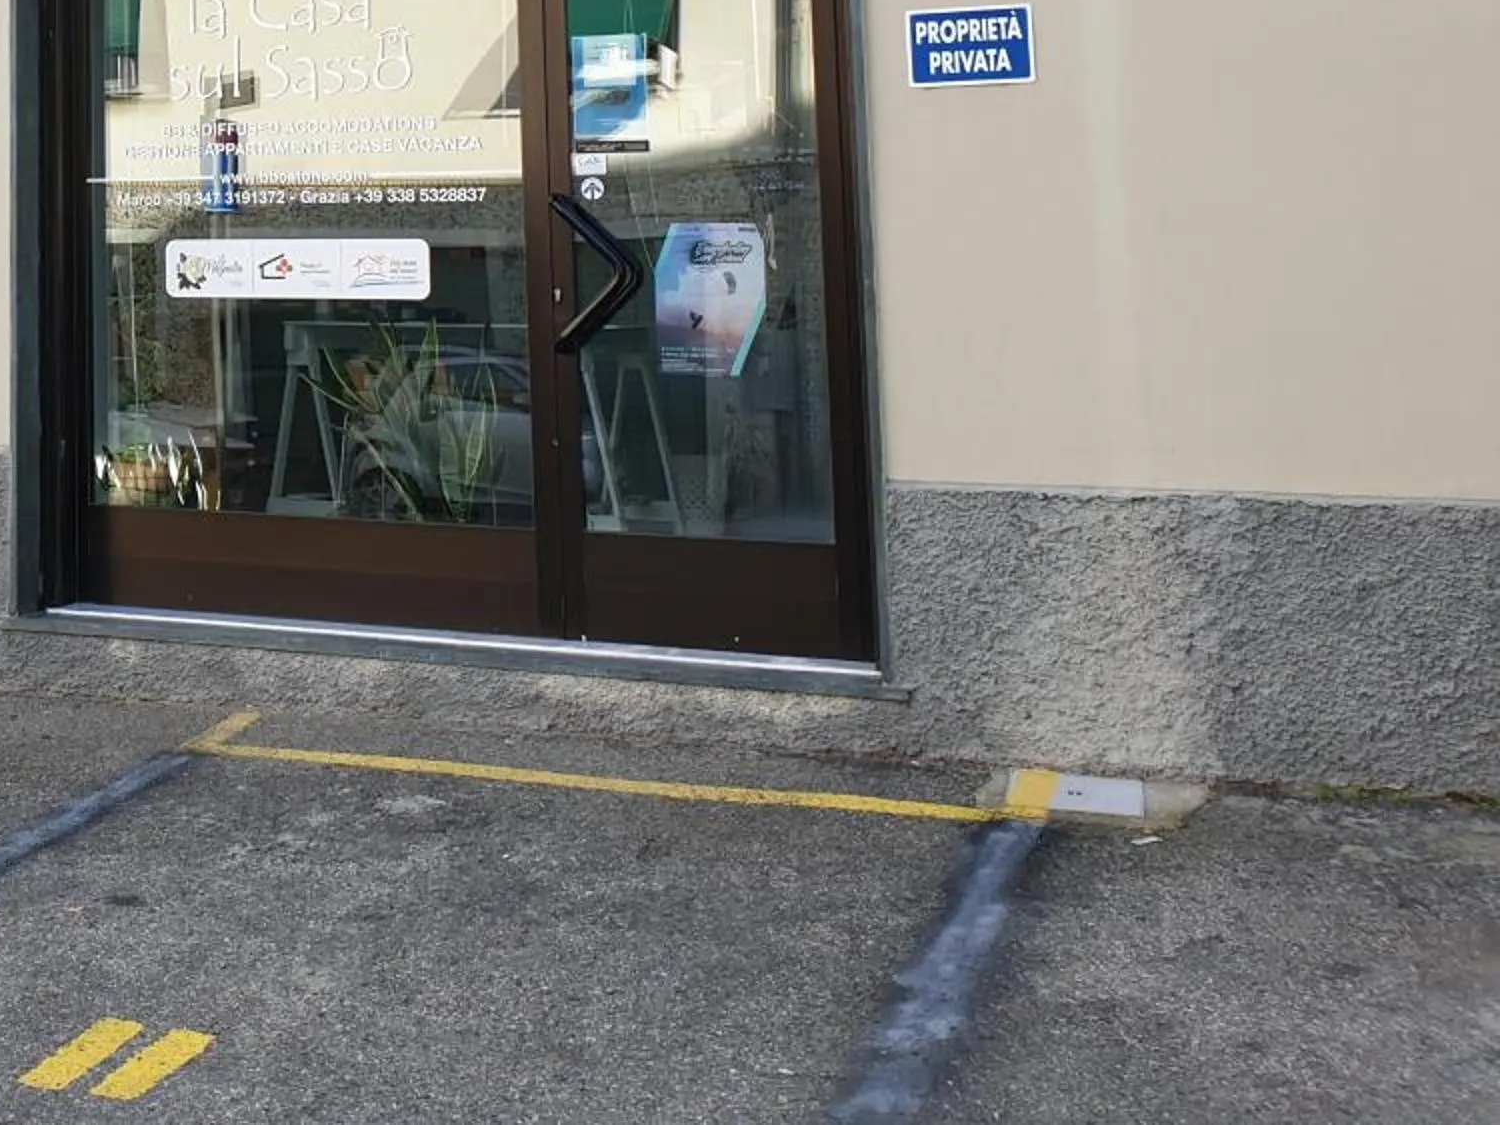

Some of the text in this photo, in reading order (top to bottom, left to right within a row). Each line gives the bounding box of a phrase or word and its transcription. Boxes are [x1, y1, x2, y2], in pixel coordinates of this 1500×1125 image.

[915, 11, 1023, 45] PROPRIETÀ
[169, 32, 413, 102] sul Sasso
[929, 48, 1012, 75] PRIVATA
[347, 137, 394, 154] CASE
[397, 134, 484, 153] VACANZA
[117, 192, 161, 206] Marco
[194, 190, 222, 205] 347
[225, 189, 286, 205] 3191372
[299, 189, 350, 205] Grazia
[353, 189, 383, 204] +39
[387, 188, 415, 204] 338
